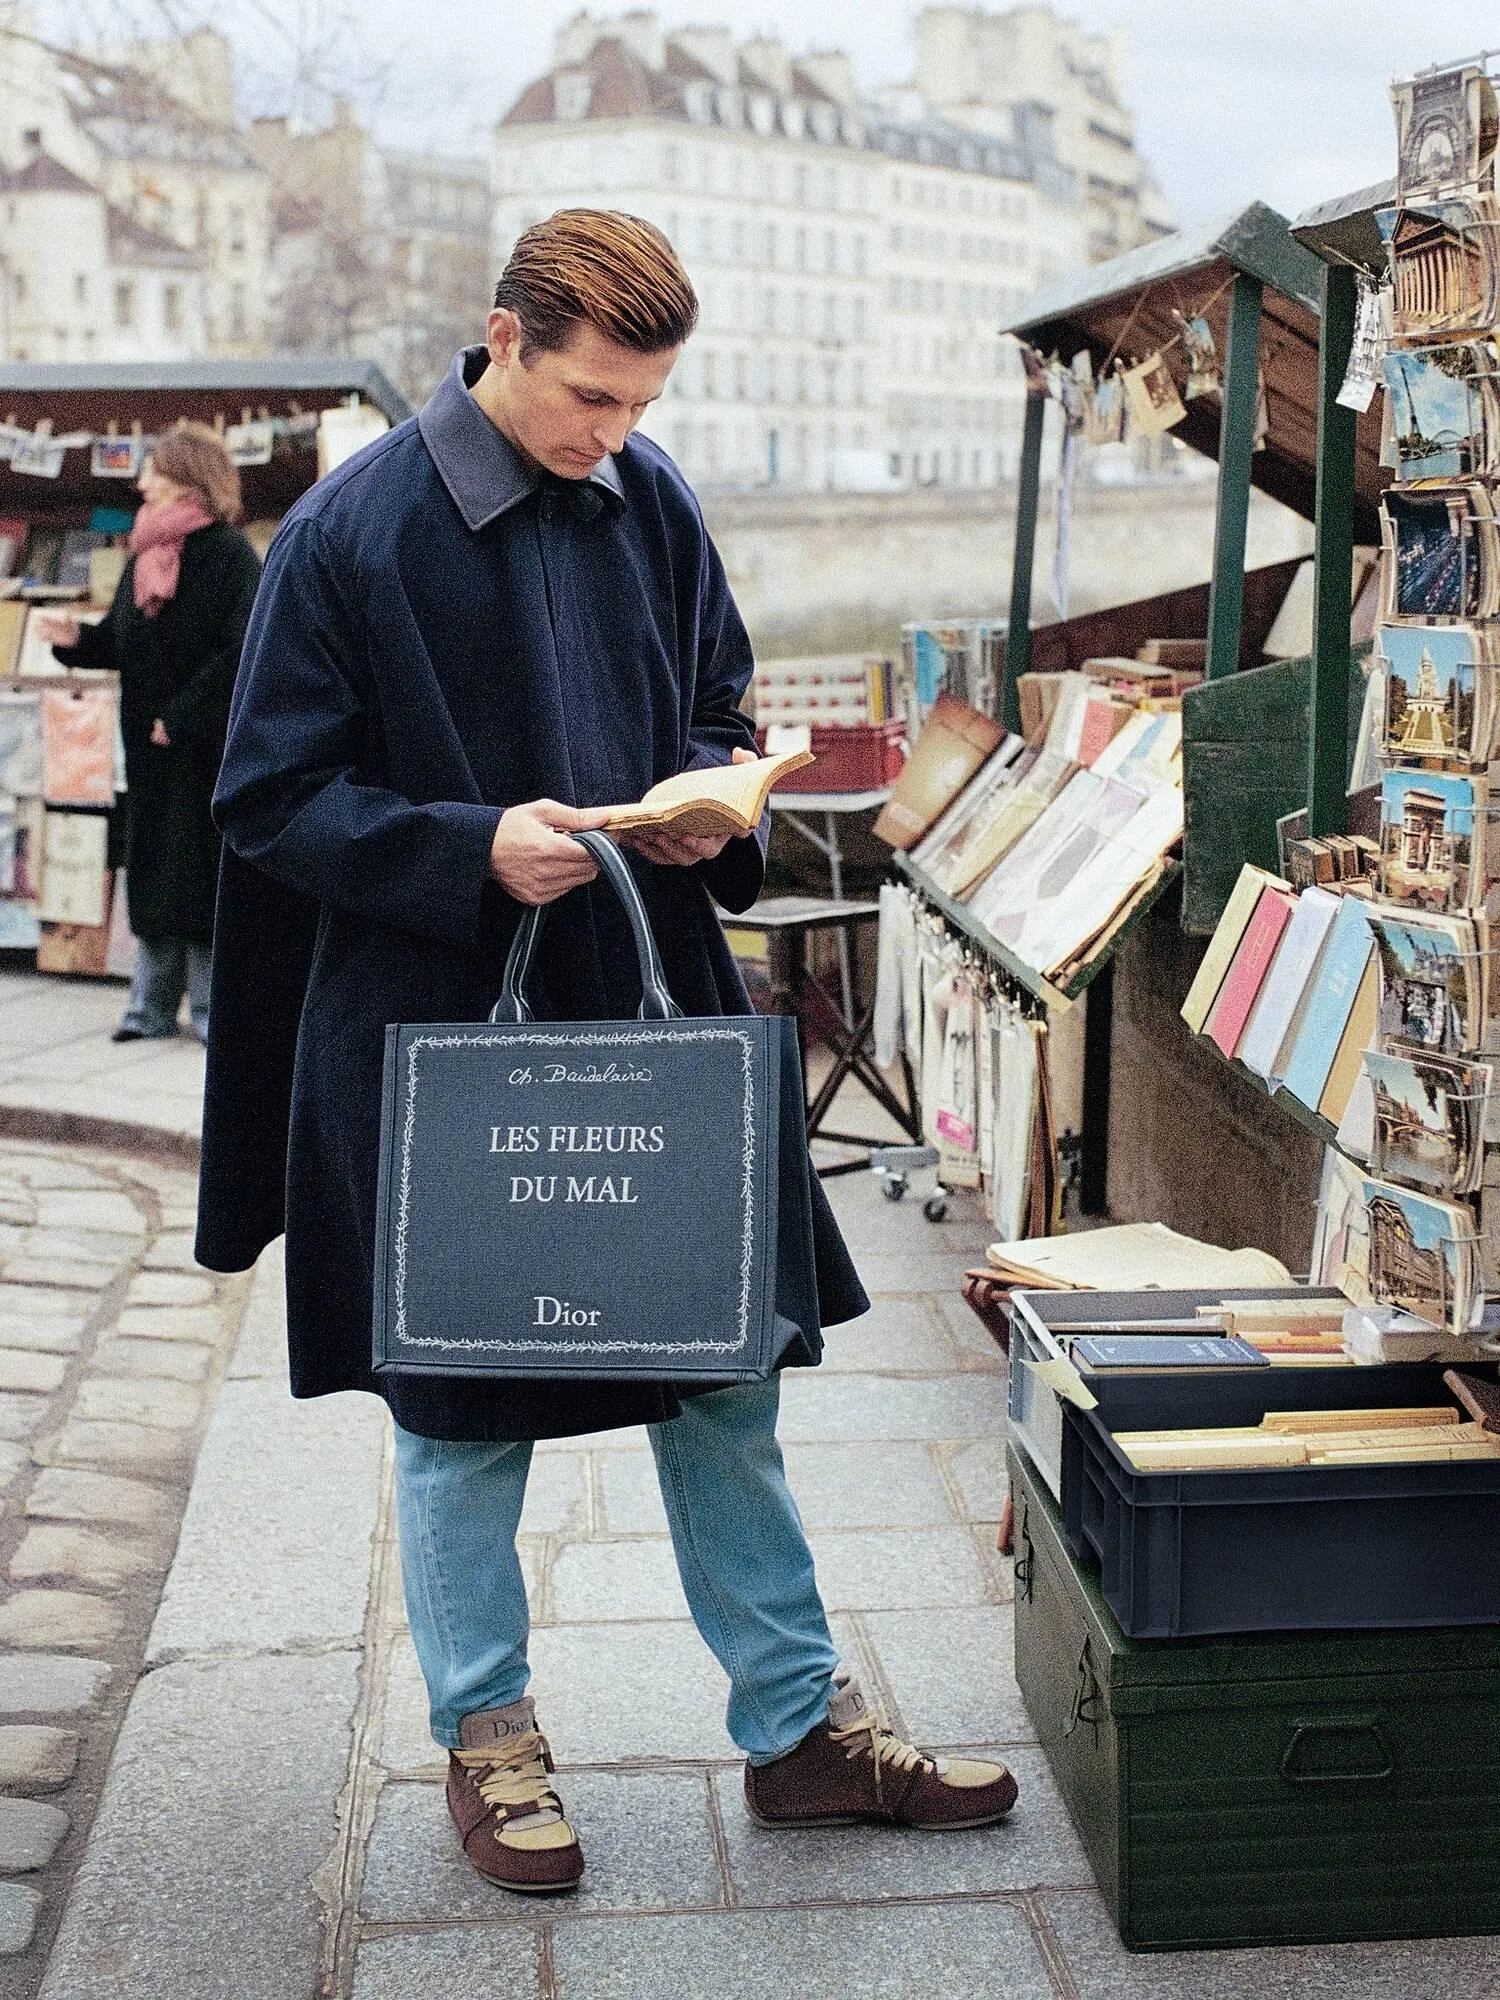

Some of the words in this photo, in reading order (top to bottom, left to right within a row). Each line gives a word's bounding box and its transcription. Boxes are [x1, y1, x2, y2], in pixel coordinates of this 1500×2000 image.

[508, 1066, 539, 1086] Ch.
[543, 1062, 653, 1083] Baudelaire
[489, 1125, 540, 1153] LES
[548, 1125, 664, 1153] FLEURS
[509, 1176, 558, 1202] DU
[565, 1176, 639, 1203] MAL
[532, 1295, 602, 1327] Dior
